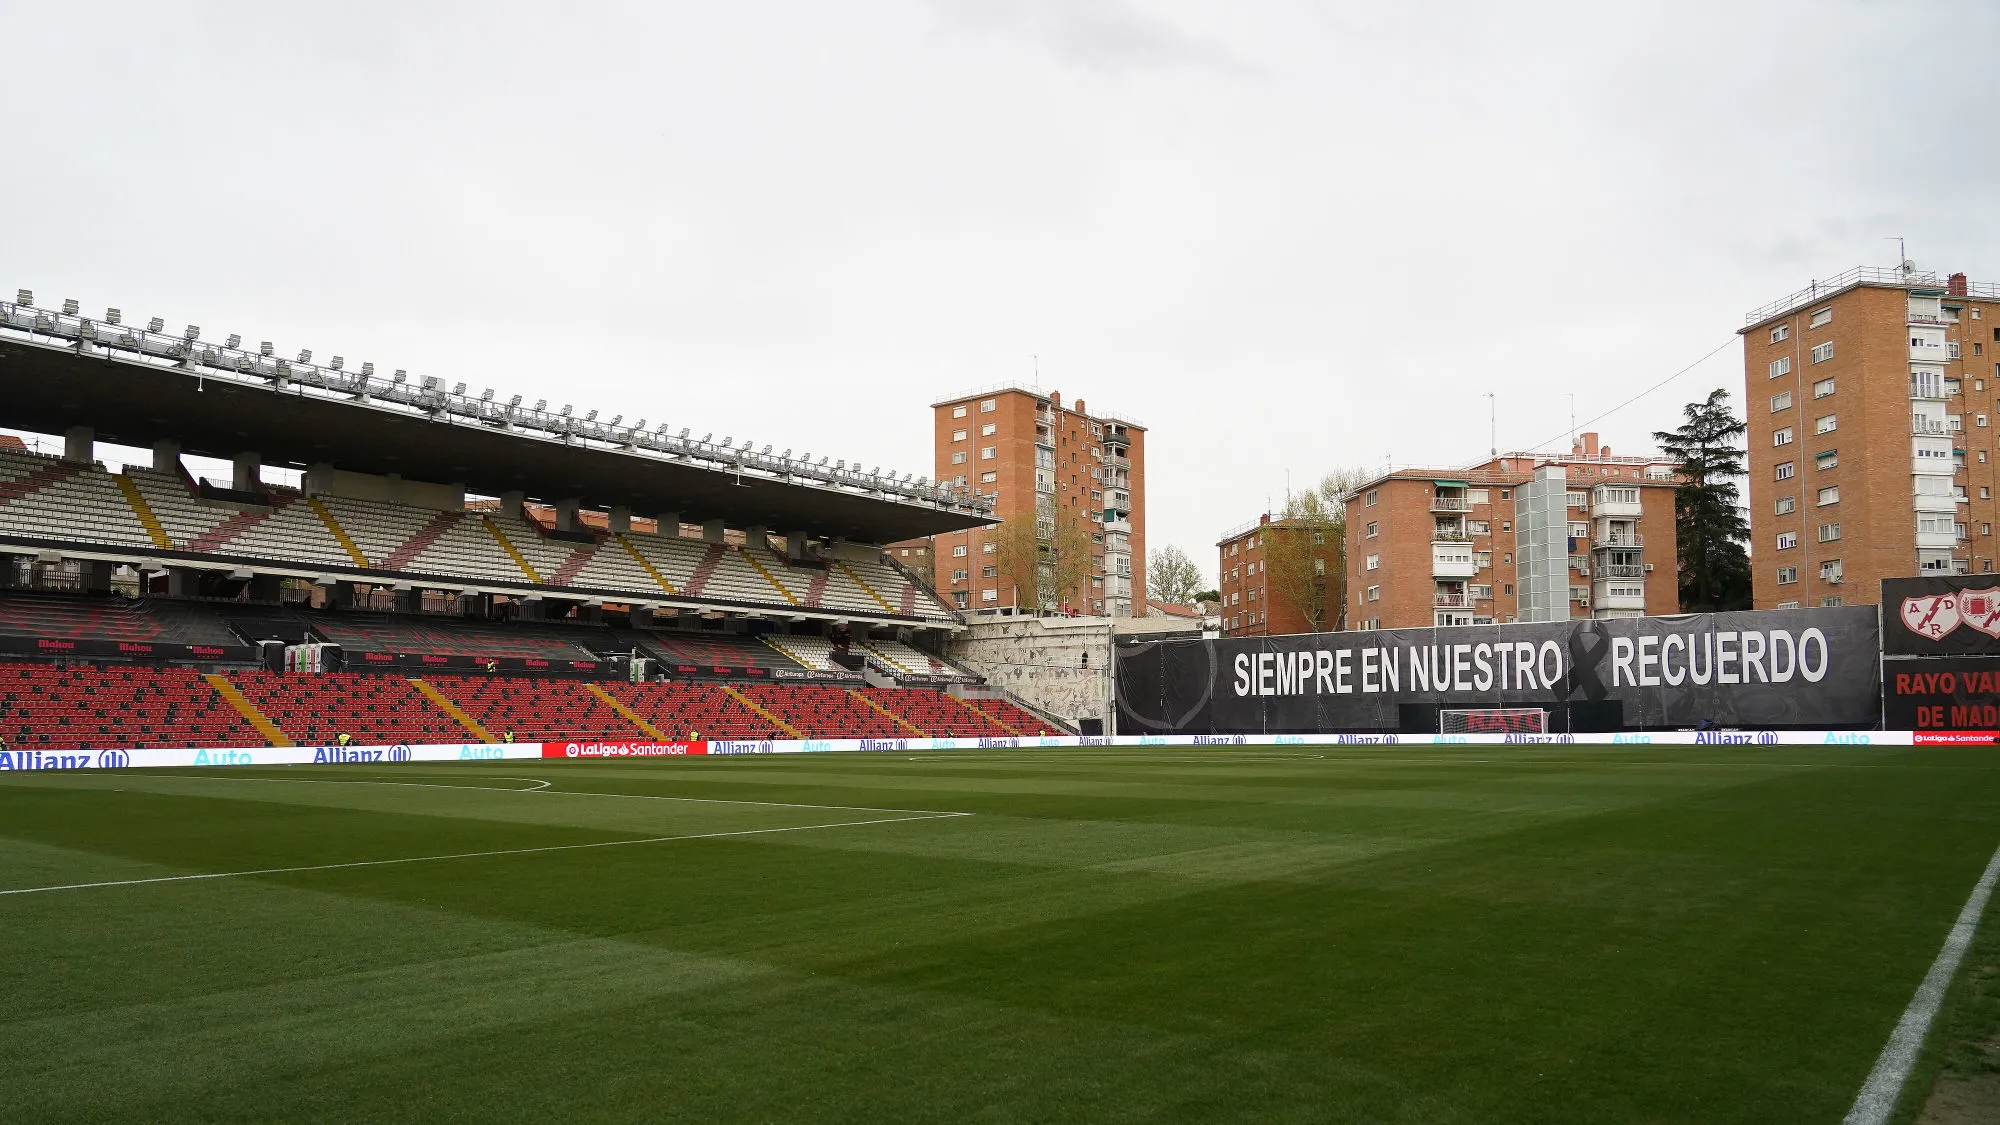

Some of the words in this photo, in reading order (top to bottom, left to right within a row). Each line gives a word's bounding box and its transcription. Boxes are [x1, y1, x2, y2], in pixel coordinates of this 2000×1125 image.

[38, 639, 75, 649] Mahou
[119, 643, 153, 652] Mahou
[193, 646, 224, 655] Mahou
[365, 652, 393, 662] Mahou
[422, 655, 448, 663] Mahou
[1234, 649, 1353, 697] SIEMPRE
[1362, 646, 1400, 693] EN
[1410, 640, 1563, 692] NUESTRO
[1612, 627, 1829, 688] RECUERDO
[1896, 673, 1955, 694] RAYO
[1917, 705, 1944, 727] DE
[978, 738, 1007, 749] Allianz
[1039, 737, 1059, 747] Auto
[1139, 735, 1166, 745] Auto
[1193, 736, 1230, 745] Allianz
[1275, 735, 1305, 745] Auto
[1337, 734, 1379, 745] Allianz
[1432, 734, 1467, 744] Auto
[1612, 733, 1651, 745] Auto
[1695, 732, 1753, 745] Allianz
[1824, 731, 1871, 745] Auto
[1923, 735, 1948, 743] LaLiga
[1955, 734, 1995, 742] Santande
[580, 743, 618, 757] LaLiga
[630, 743, 689, 756] Santander
[714, 741, 756, 755] Allianz
[802, 740, 831, 753] Auto
[859, 740, 894, 751] Allianz
[931, 739, 956, 750] Auto
[194, 749, 253, 767] Auto
[314, 747, 383, 764] Allianz
[459, 745, 504, 760] Auto
[0, 751, 91, 770] Allianz
